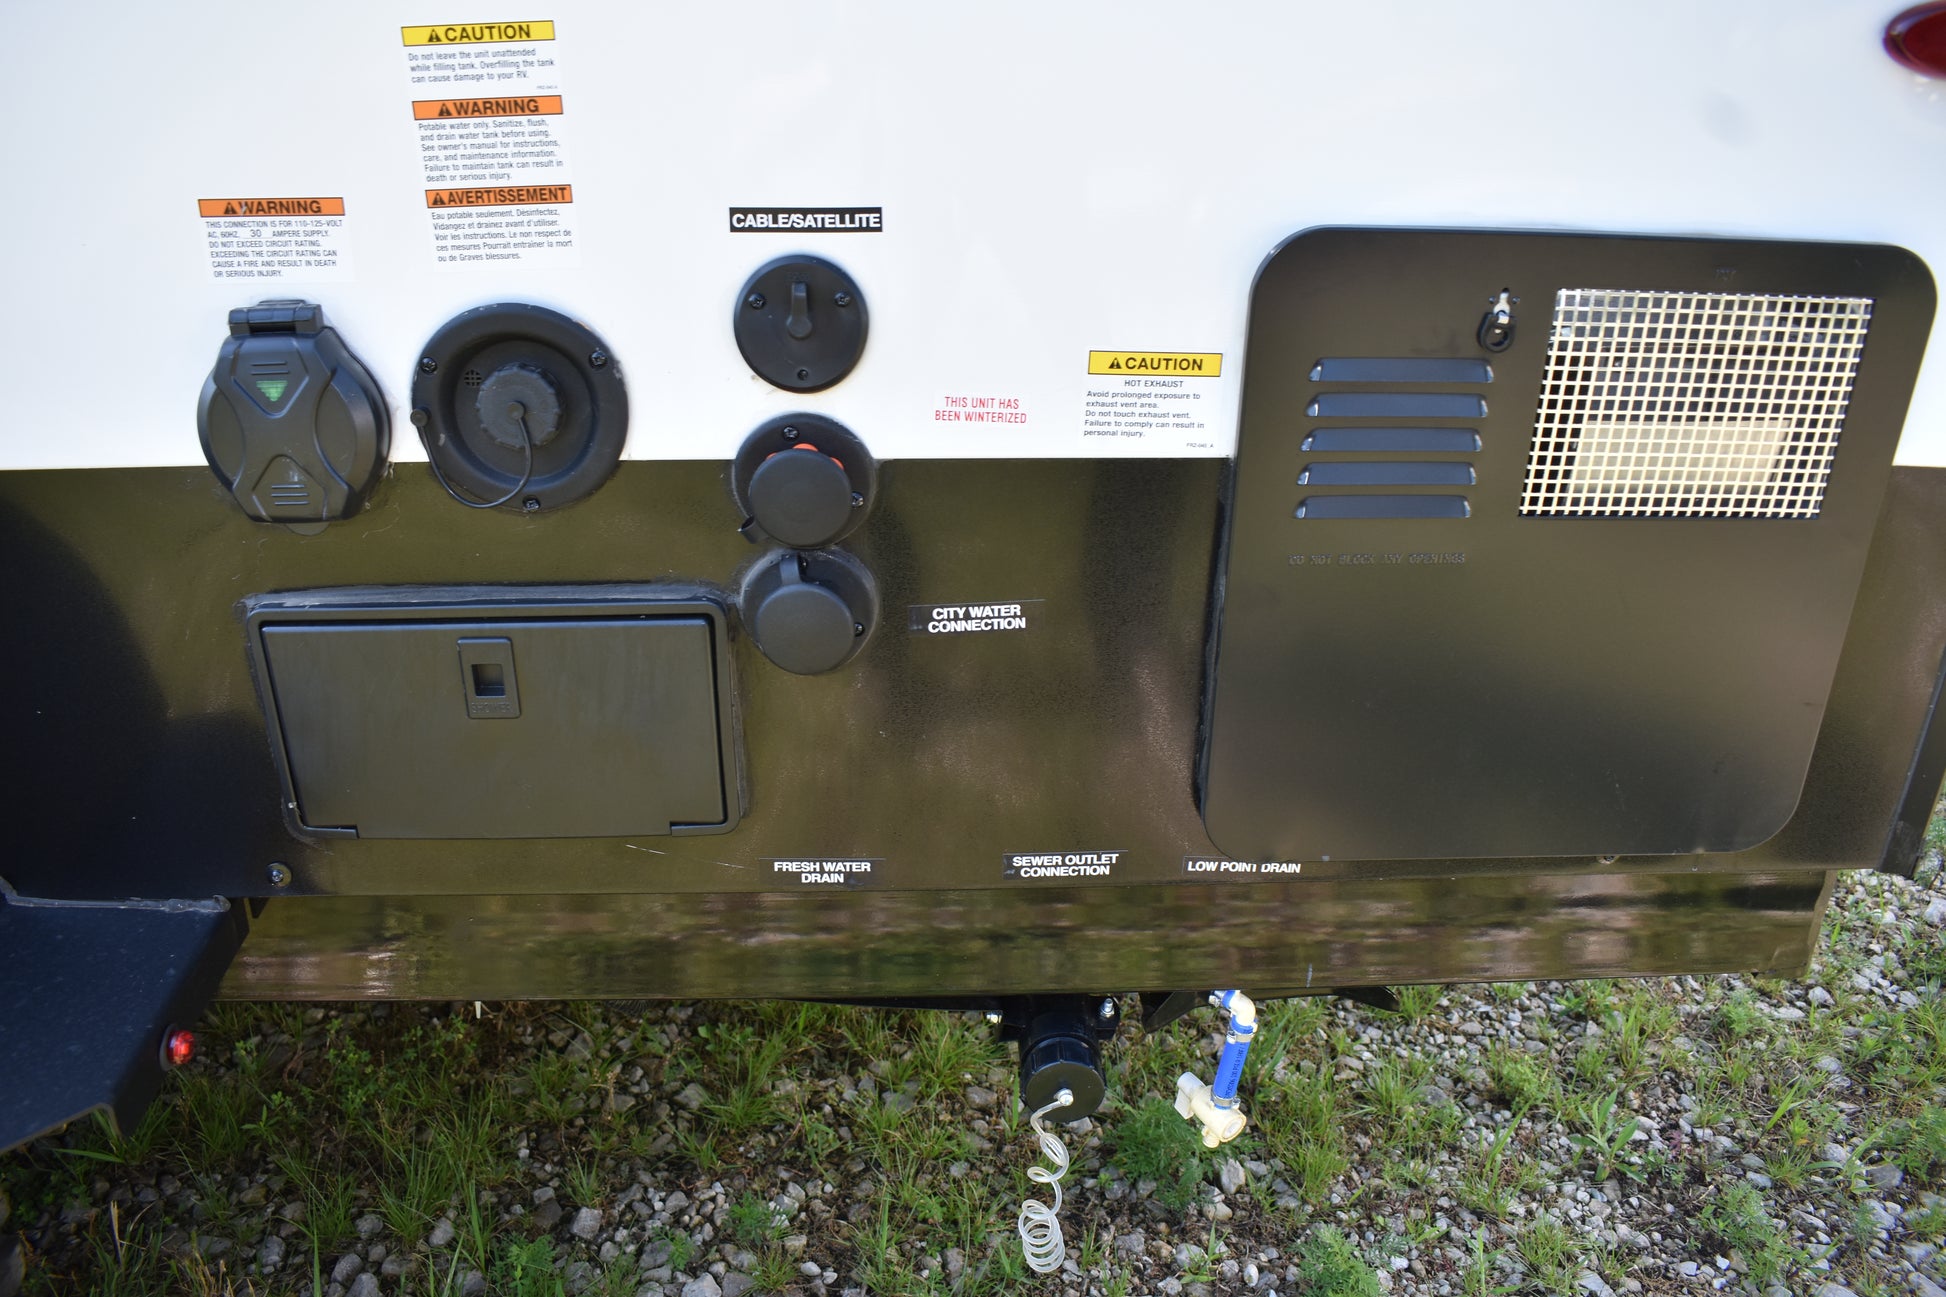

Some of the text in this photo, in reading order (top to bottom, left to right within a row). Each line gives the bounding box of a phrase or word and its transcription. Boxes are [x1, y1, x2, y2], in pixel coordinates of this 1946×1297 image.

[445, 24, 531, 42] CAUTION
[408, 48, 536, 61] Do not leave the unit unattended
[410, 59, 554, 72] while filling tank. Overfilling the tank
[428, 74, 450, 82] cause
[454, 73, 484, 82] damage
[498, 71, 514, 81] your
[454, 99, 539, 115] WARNING
[419, 122, 447, 131] Potable
[421, 130, 551, 141] and drain water tank before using.
[421, 144, 435, 152] See
[438, 142, 467, 151] owner's
[470, 141, 498, 149] manual
[444, 153, 458, 161] and
[460, 151, 508, 160] maintenance
[511, 150, 557, 158] information.
[425, 164, 450, 172] Failure
[462, 161, 495, 170] maintain
[532, 159, 555, 168] result
[557, 159, 563, 167] in
[426, 171, 512, 182] death or serious injury.
[448, 187, 567, 204] AVERTISSEMENT
[239, 200, 321, 215] WARNING
[432, 212, 444, 220] Eau
[447, 211, 473, 220] potable
[732, 213, 881, 228] CABLE/SATELLITE
[224, 220, 268, 228] CONNECTION
[433, 221, 466, 231] Vidangez
[477, 220, 502, 228] drainez
[250, 229, 262, 238] 30
[435, 233, 448, 241] Voir
[535, 229, 561, 239] respect
[237, 240, 263, 248] EXCEED
[451, 242, 480, 250] mesures
[483, 241, 511, 250] Pourrait
[438, 254, 447, 262] ou
[449, 253, 457, 261] de
[460, 253, 483, 261] Graves
[212, 260, 235, 268] CAUSE
[315, 259, 336, 267] DEATH
[214, 270, 223, 278] OR
[226, 270, 255, 278] SERIOUS
[1125, 358, 1203, 371] CAUTION
[1111, 391, 1152, 399] prolonged
[945, 396, 1019, 409] THIS UNIT HAS
[935, 410, 1026, 423] BEEN WINTERIZED
[1121, 430, 1146, 438] injury.
[932, 604, 1021, 620] CITY WATER
[928, 617, 1026, 633] CONNECTION
[1012, 854, 1119, 867] SEWER OUTLET
[774, 862, 871, 872] FRESH WATER
[1020, 865, 1110, 877] CONNECTION
[1188, 861, 1218, 872] LOW
[1261, 863, 1301, 873] DRAIN
[801, 873, 844, 883] DRAIN
